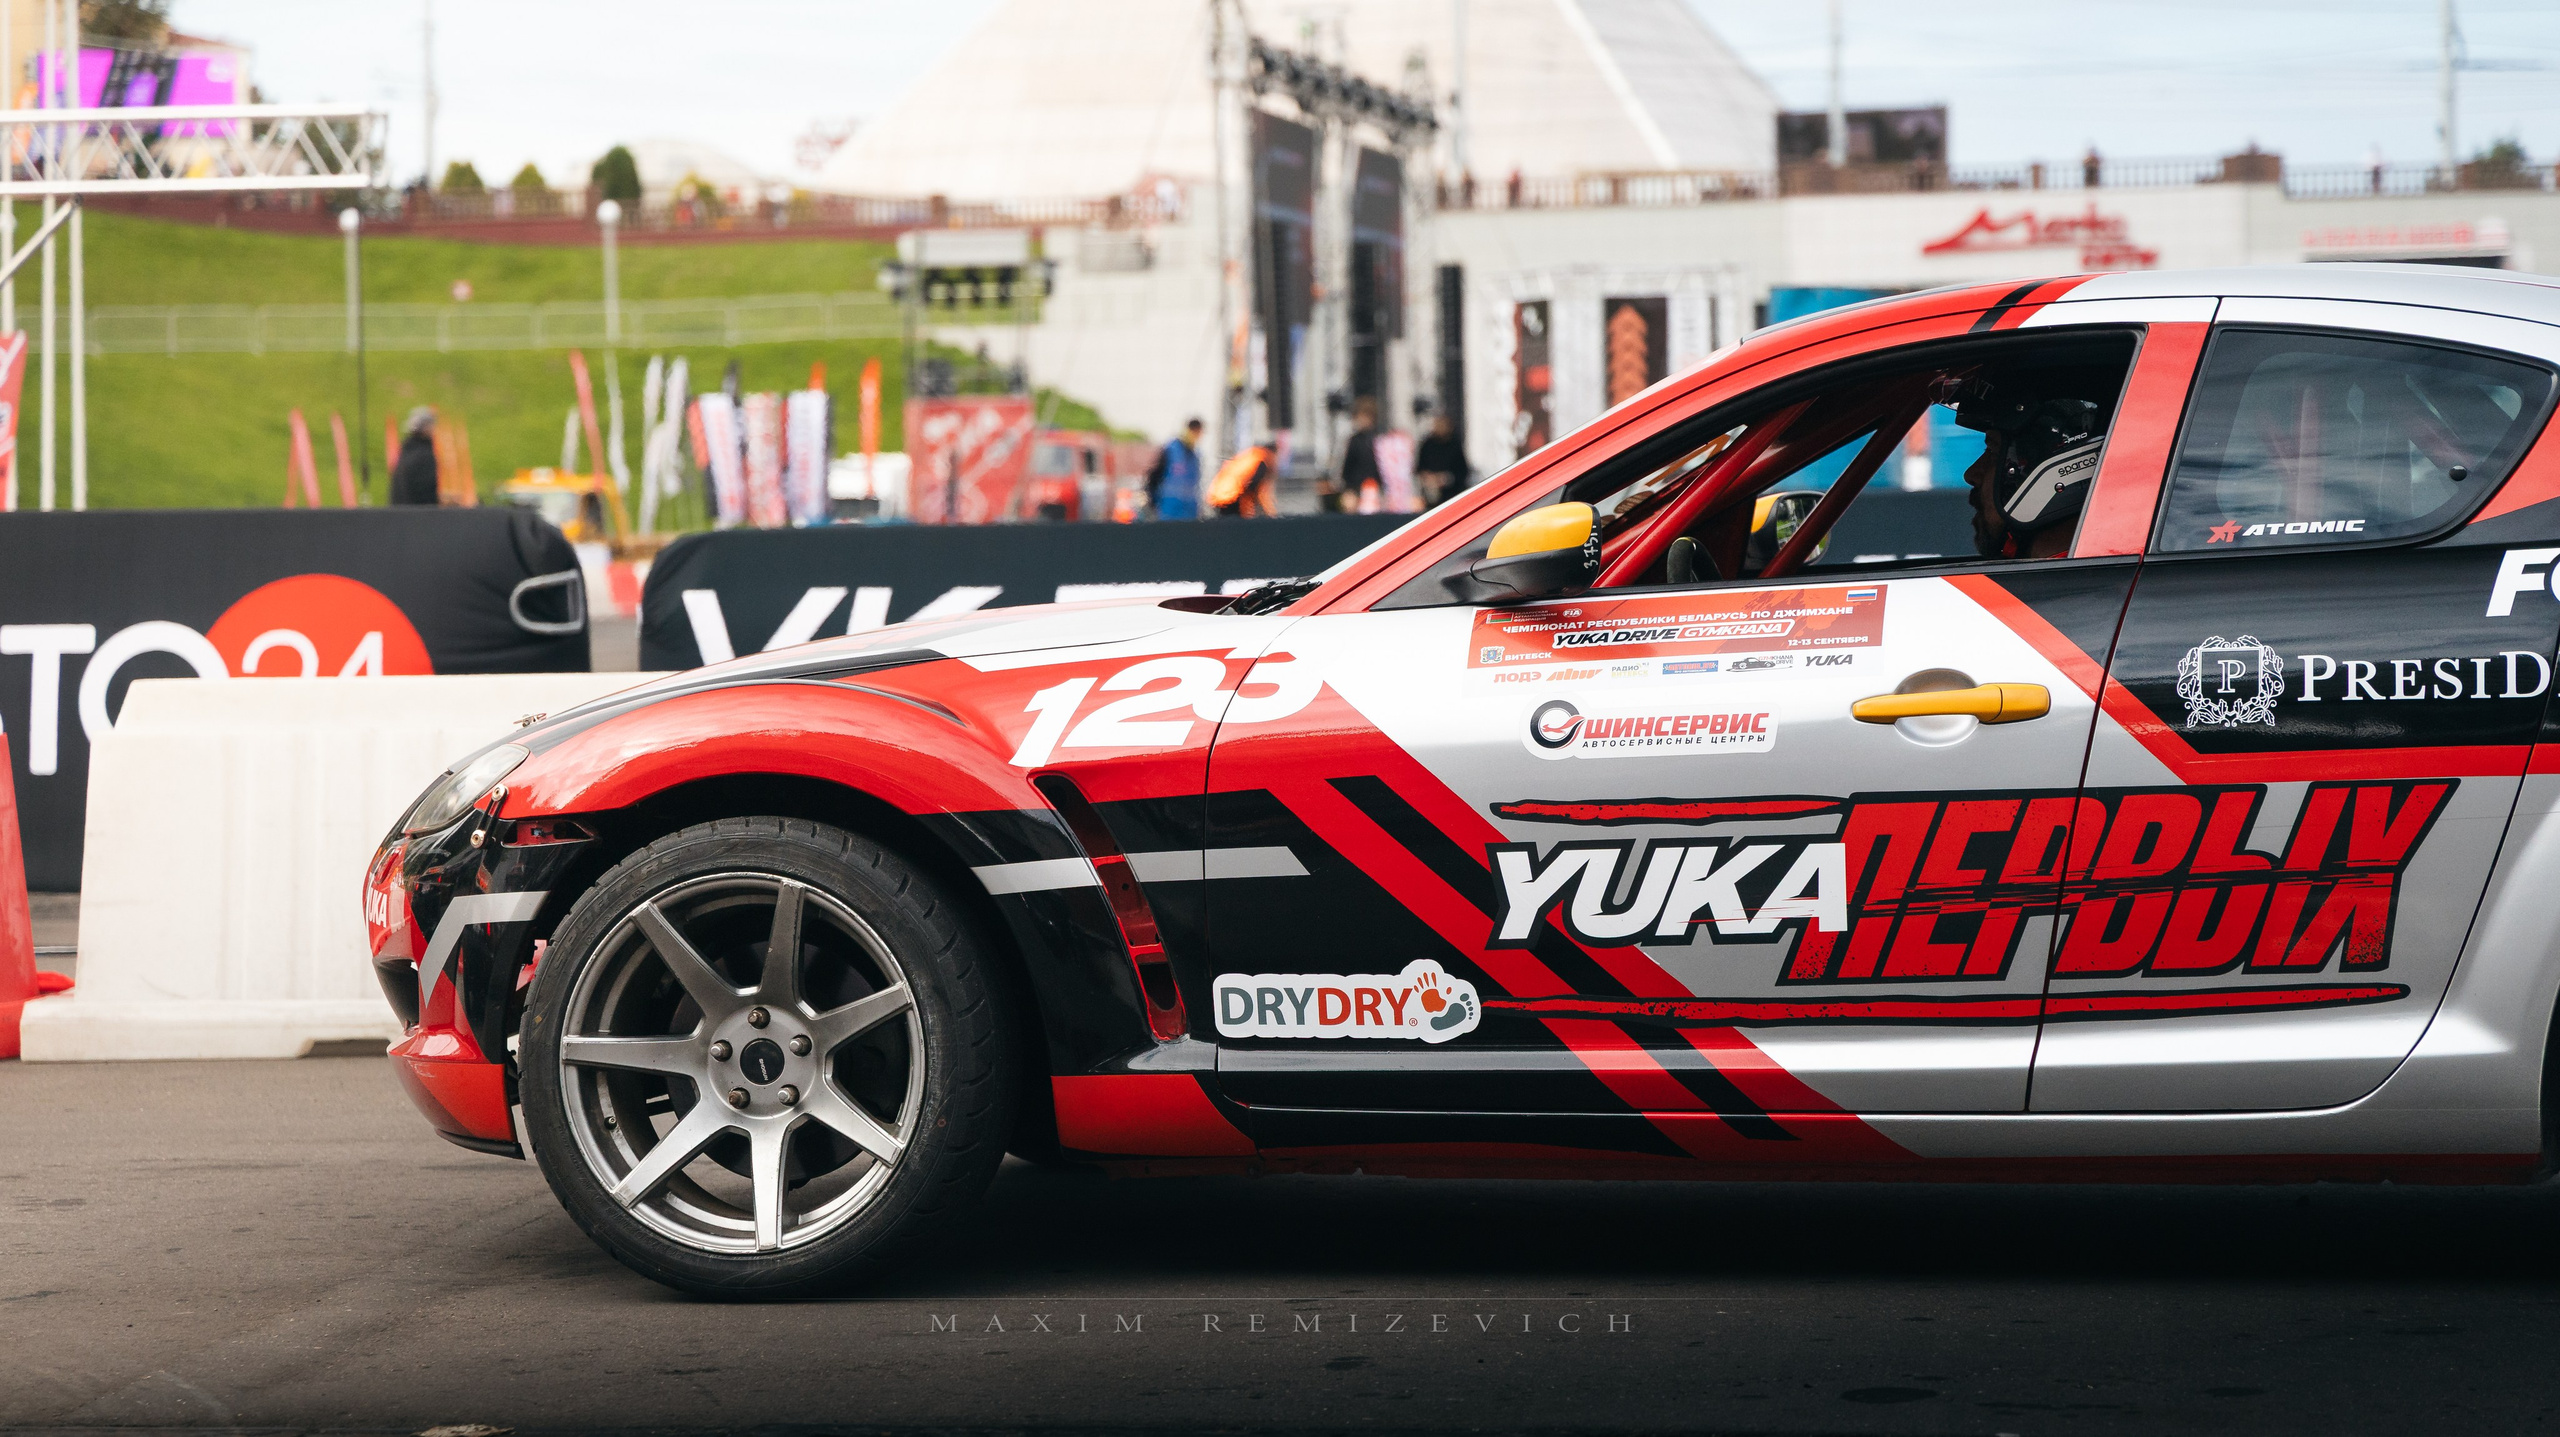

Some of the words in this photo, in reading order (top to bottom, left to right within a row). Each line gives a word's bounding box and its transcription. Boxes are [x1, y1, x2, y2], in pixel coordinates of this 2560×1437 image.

[2242, 519, 2366, 537] ATOMIC
[2486, 547, 2560, 617] F
[1502, 621, 1585, 634] ЧЕМПИОНАТ
[1587, 616, 1676, 629] РЕСПУБЛИКИ
[1679, 612, 1748, 623] БЕЛАРУСЬ
[1751, 610, 1769, 619] ПО
[1773, 606, 1854, 619] ДЖИМХАНЕ
[1564, 609, 1582, 617] FIA
[1556, 631, 1610, 646] YUKA
[1611, 628, 1680, 643] DRIVE
[1684, 623, 1783, 637] GYMKHANA
[1787, 639, 1812, 647] 12-13
[1813, 635, 1869, 646] СЕНТЯБРЯ
[1504, 651, 1552, 662] ВИТЕБСК
[1805, 654, 1853, 667] YUKA
[2298, 650, 2560, 701] PRESID
[1008, 643, 1325, 768] 123
[1583, 712, 1770, 739] ШИНСЕРВИС
[1582, 736, 1703, 748] АВТОСЕРВИСНЫЕ
[1710, 735, 1766, 745] ЦЕНТРЫ
[1496, 842, 1848, 940] YUKA
[1219, 986, 1413, 1026] DRYDRY
